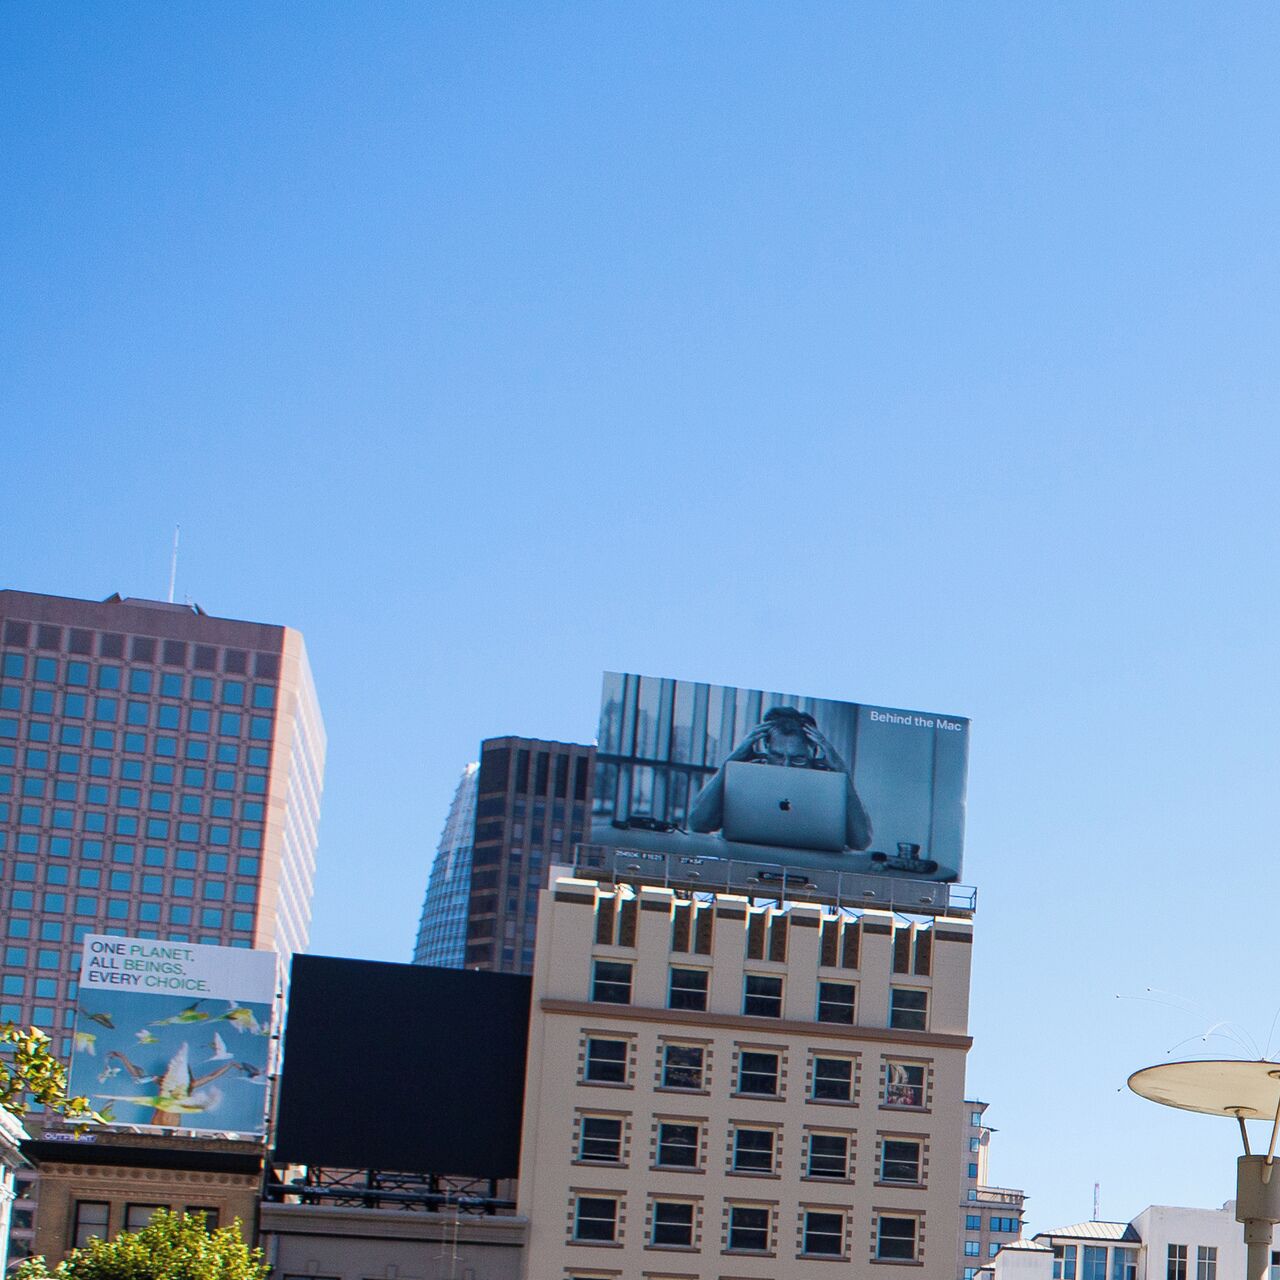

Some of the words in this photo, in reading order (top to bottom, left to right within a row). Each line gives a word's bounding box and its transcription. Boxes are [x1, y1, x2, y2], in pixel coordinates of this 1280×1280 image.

[870, 711, 912, 726] Behind
[914, 717, 934, 728] the
[936, 719, 962, 731] Mac
[91, 941, 126, 956] ONE
[129, 945, 195, 962] PLANET.
[89, 956, 119, 970] ALL
[123, 959, 186, 975] BEINGS.
[88, 970, 142, 985] EVERY
[145, 976, 211, 992] CHOICE.
